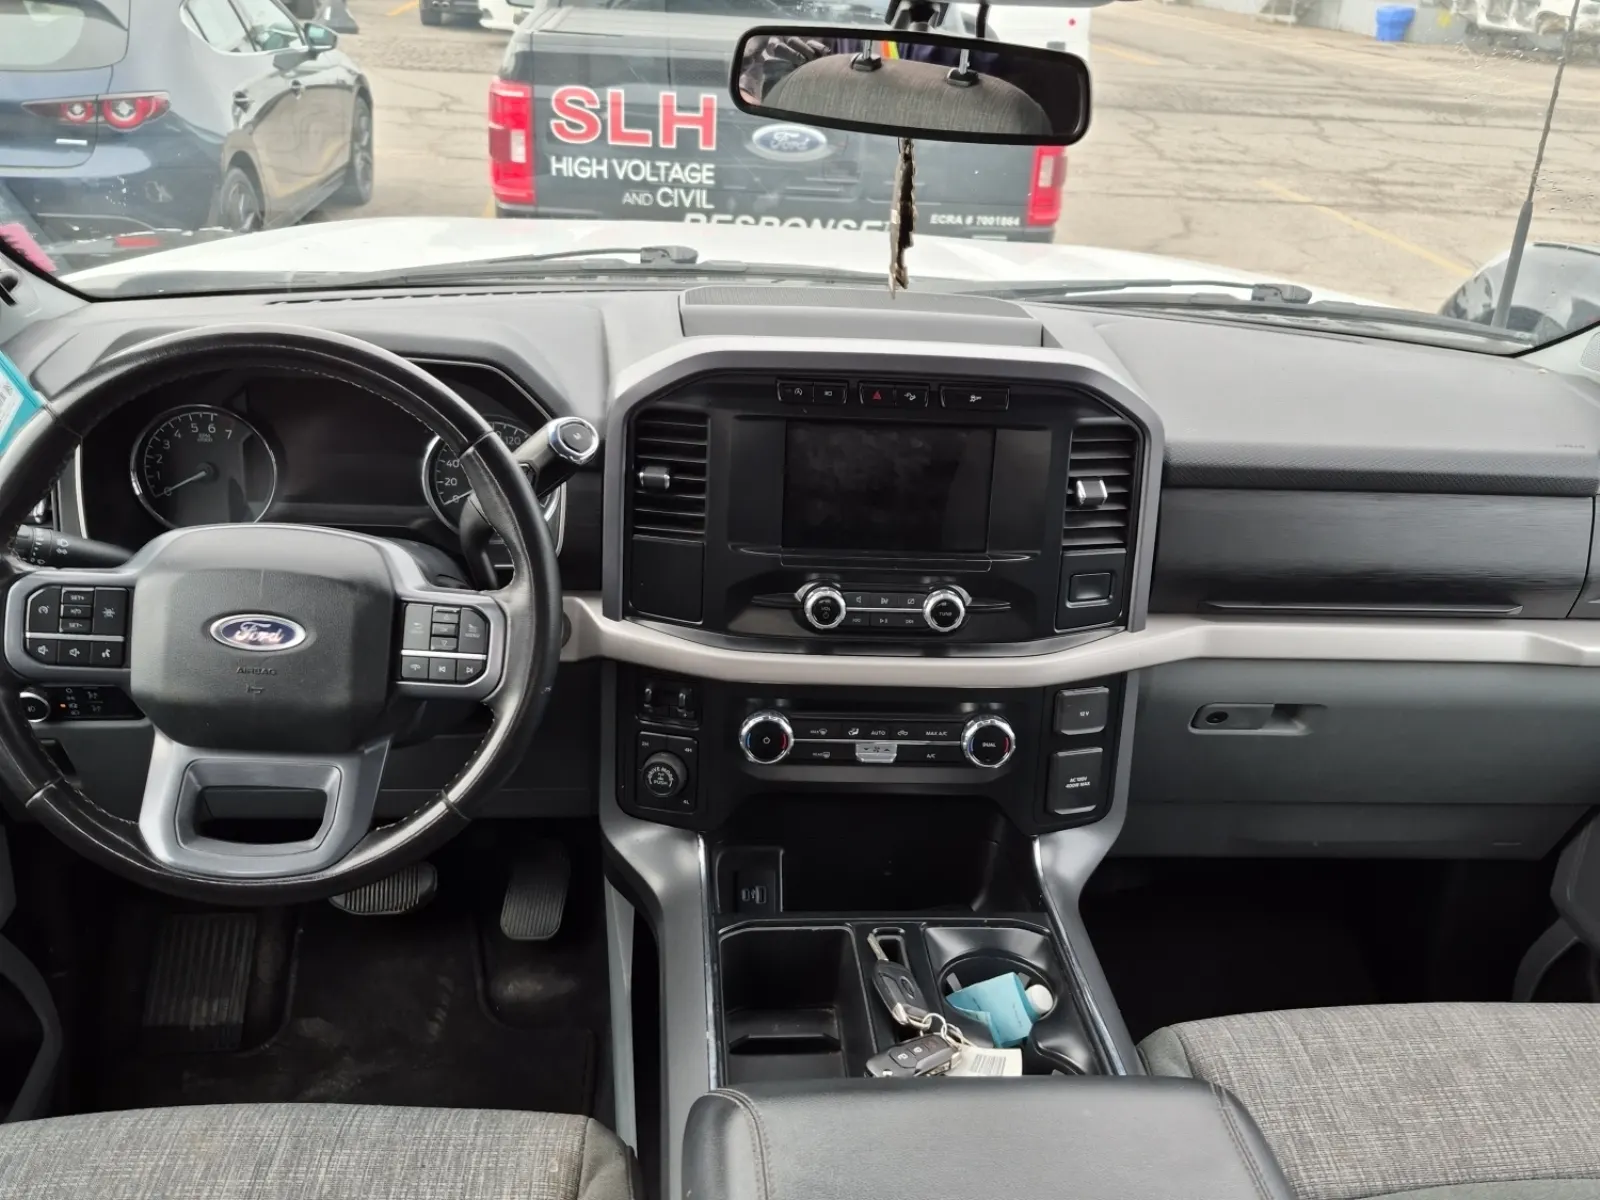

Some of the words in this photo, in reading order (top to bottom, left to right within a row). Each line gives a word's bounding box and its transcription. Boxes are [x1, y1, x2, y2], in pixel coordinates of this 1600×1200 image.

[550, 85, 718, 150] SLH
[550, 155, 609, 179] HIGH
[611, 159, 715, 184] VOLTAGE
[622, 191, 654, 206] AND
[656, 187, 715, 209] CIVIL
[930, 214, 963, 225] ECRA
[191, 423, 199, 433] 5
[208, 423, 216, 434] 6
[225, 429, 232, 440] 7
[163, 440, 170, 449] 3
[156, 454, 163, 464] 2
[447, 459, 460, 468] 40
[445, 478, 458, 486] 20
[233, 621, 283, 646] Ford
